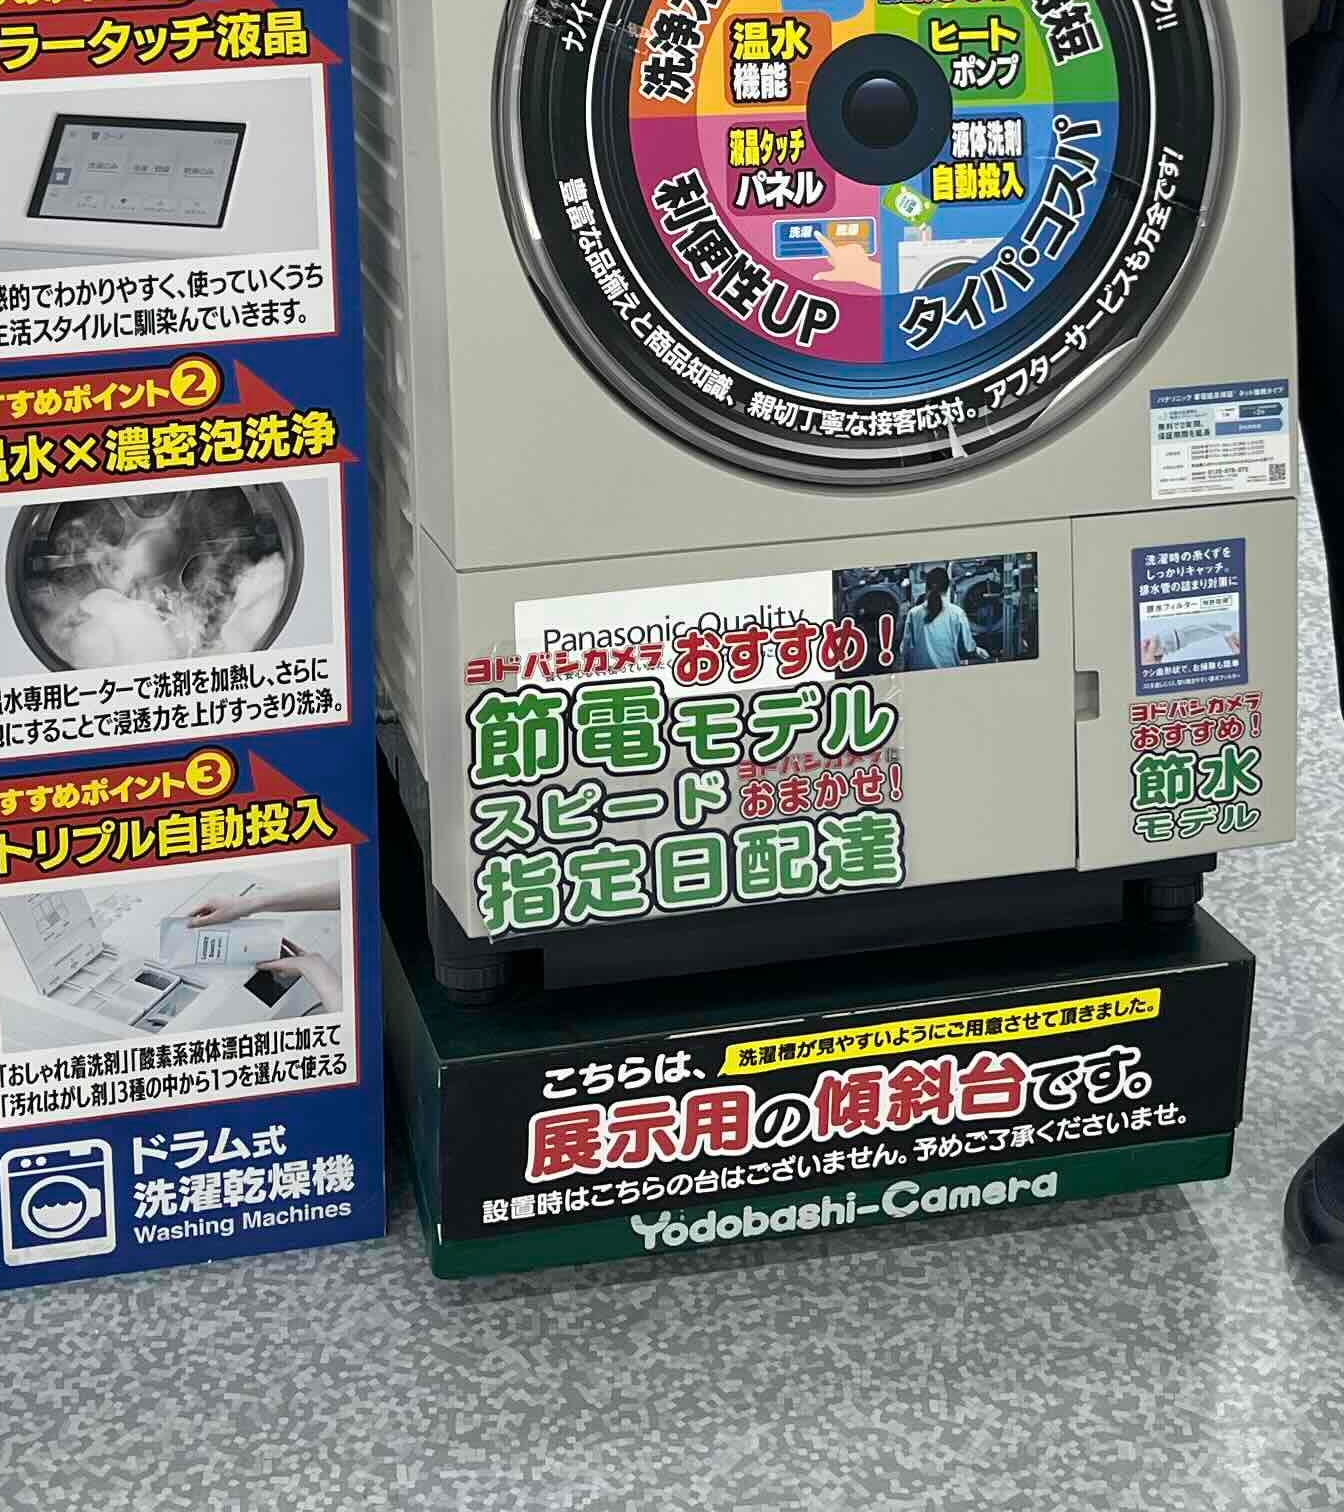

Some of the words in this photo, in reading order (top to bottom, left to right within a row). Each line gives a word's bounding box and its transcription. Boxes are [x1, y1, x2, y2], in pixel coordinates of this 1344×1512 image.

[733, 20, 808, 62] 温水
[929, 19, 1018, 51] ヒート
[734, 63, 788, 101] 機能
[953, 54, 1020, 88] ポンプ
[952, 120, 1022, 159] 液体洗剤
[737, 172, 823, 208] パネル
[932, 163, 1024, 202] 自動投入
[654, 168, 839, 347] 利便性UP
[900, 115, 1101, 350] タイパ・コスパ
[1144, 547, 1231, 566] 洗濯時の糸くずを
[464, 642, 666, 685] ヨドバシカメラ
[469, 679, 897, 785] 節電モデル
[1130, 692, 1263, 723] ヨドバシカメラ
[1131, 743, 1261, 810] 節水
[473, 769, 730, 850] スピード
[1134, 803, 1261, 841] モデル
[476, 811, 906, 936] 指定日配達
[0, 1024, 342, 1087] 「おしゃれ着洗剤」「酸素系液体漂白剤」に加えて
[737, 999, 1155, 1068] 洗濯槽が見やすいようにご用意させて頂きました。
[0, 1054, 348, 1117] 「汚れはがし剤」3種の中から1つを選んで使える
[544, 1049, 709, 1100] こちらは、
[526, 1046, 1154, 1181] 展示用の傾斜台です。
[132, 1125, 287, 1175] ドラム式
[482, 1105, 1189, 1224] 設置時はこちらの台はございません。予めご了承くださいませ。
[133, 1155, 355, 1220] 洗濯乾燥機
[630, 1171, 1058, 1252] Yodobashi-Camera
[133, 1217, 234, 1245] Washing
[242, 1201, 351, 1229] Machines
